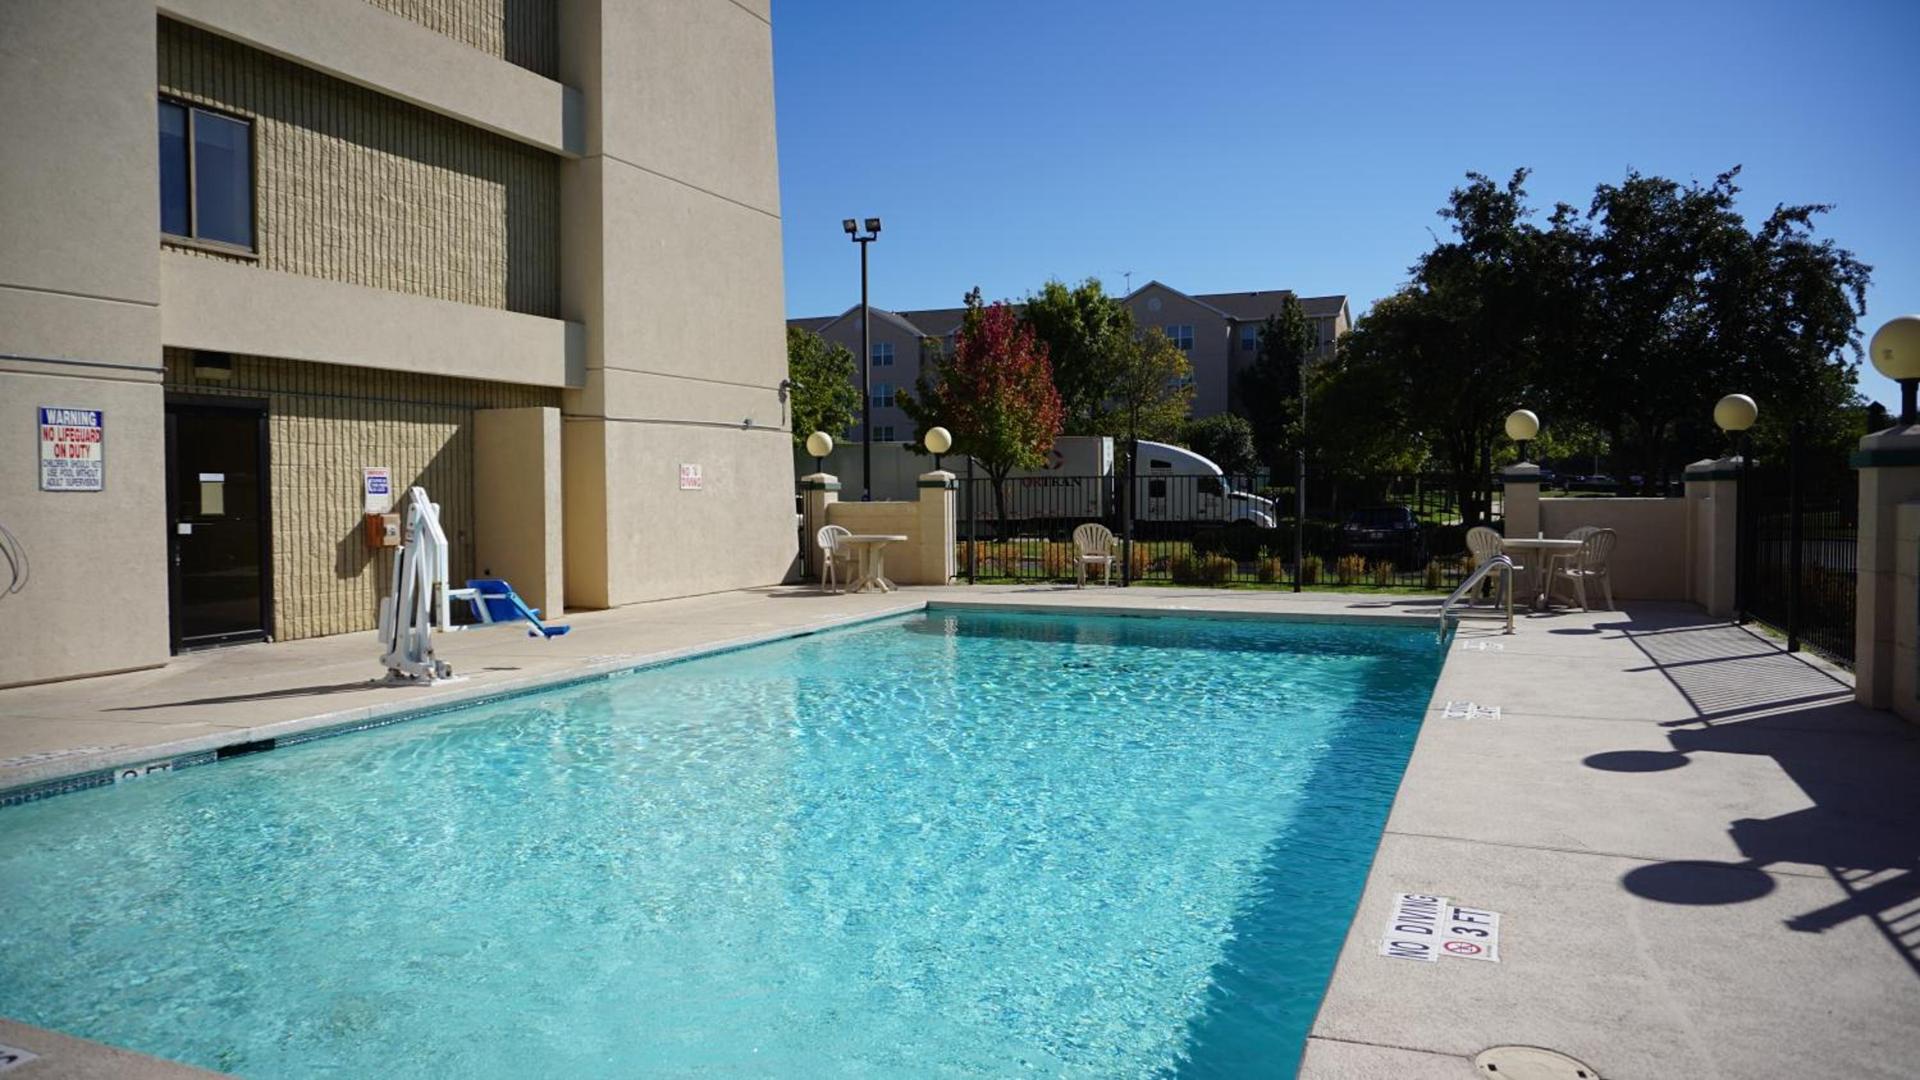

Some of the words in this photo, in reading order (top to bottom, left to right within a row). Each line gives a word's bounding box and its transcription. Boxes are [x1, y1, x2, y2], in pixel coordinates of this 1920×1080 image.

[46, 409, 97, 426] WARNING
[43, 427, 54, 441] NO
[58, 427, 101, 443] LIFEGUARD
[54, 444, 66, 458] ON
[69, 444, 90, 459] DUTY
[1395, 894, 1438, 935] DIVING
[1452, 908, 1491, 925] FT
[1451, 926, 1489, 938] 3
[1388, 941, 1430, 960] NO
